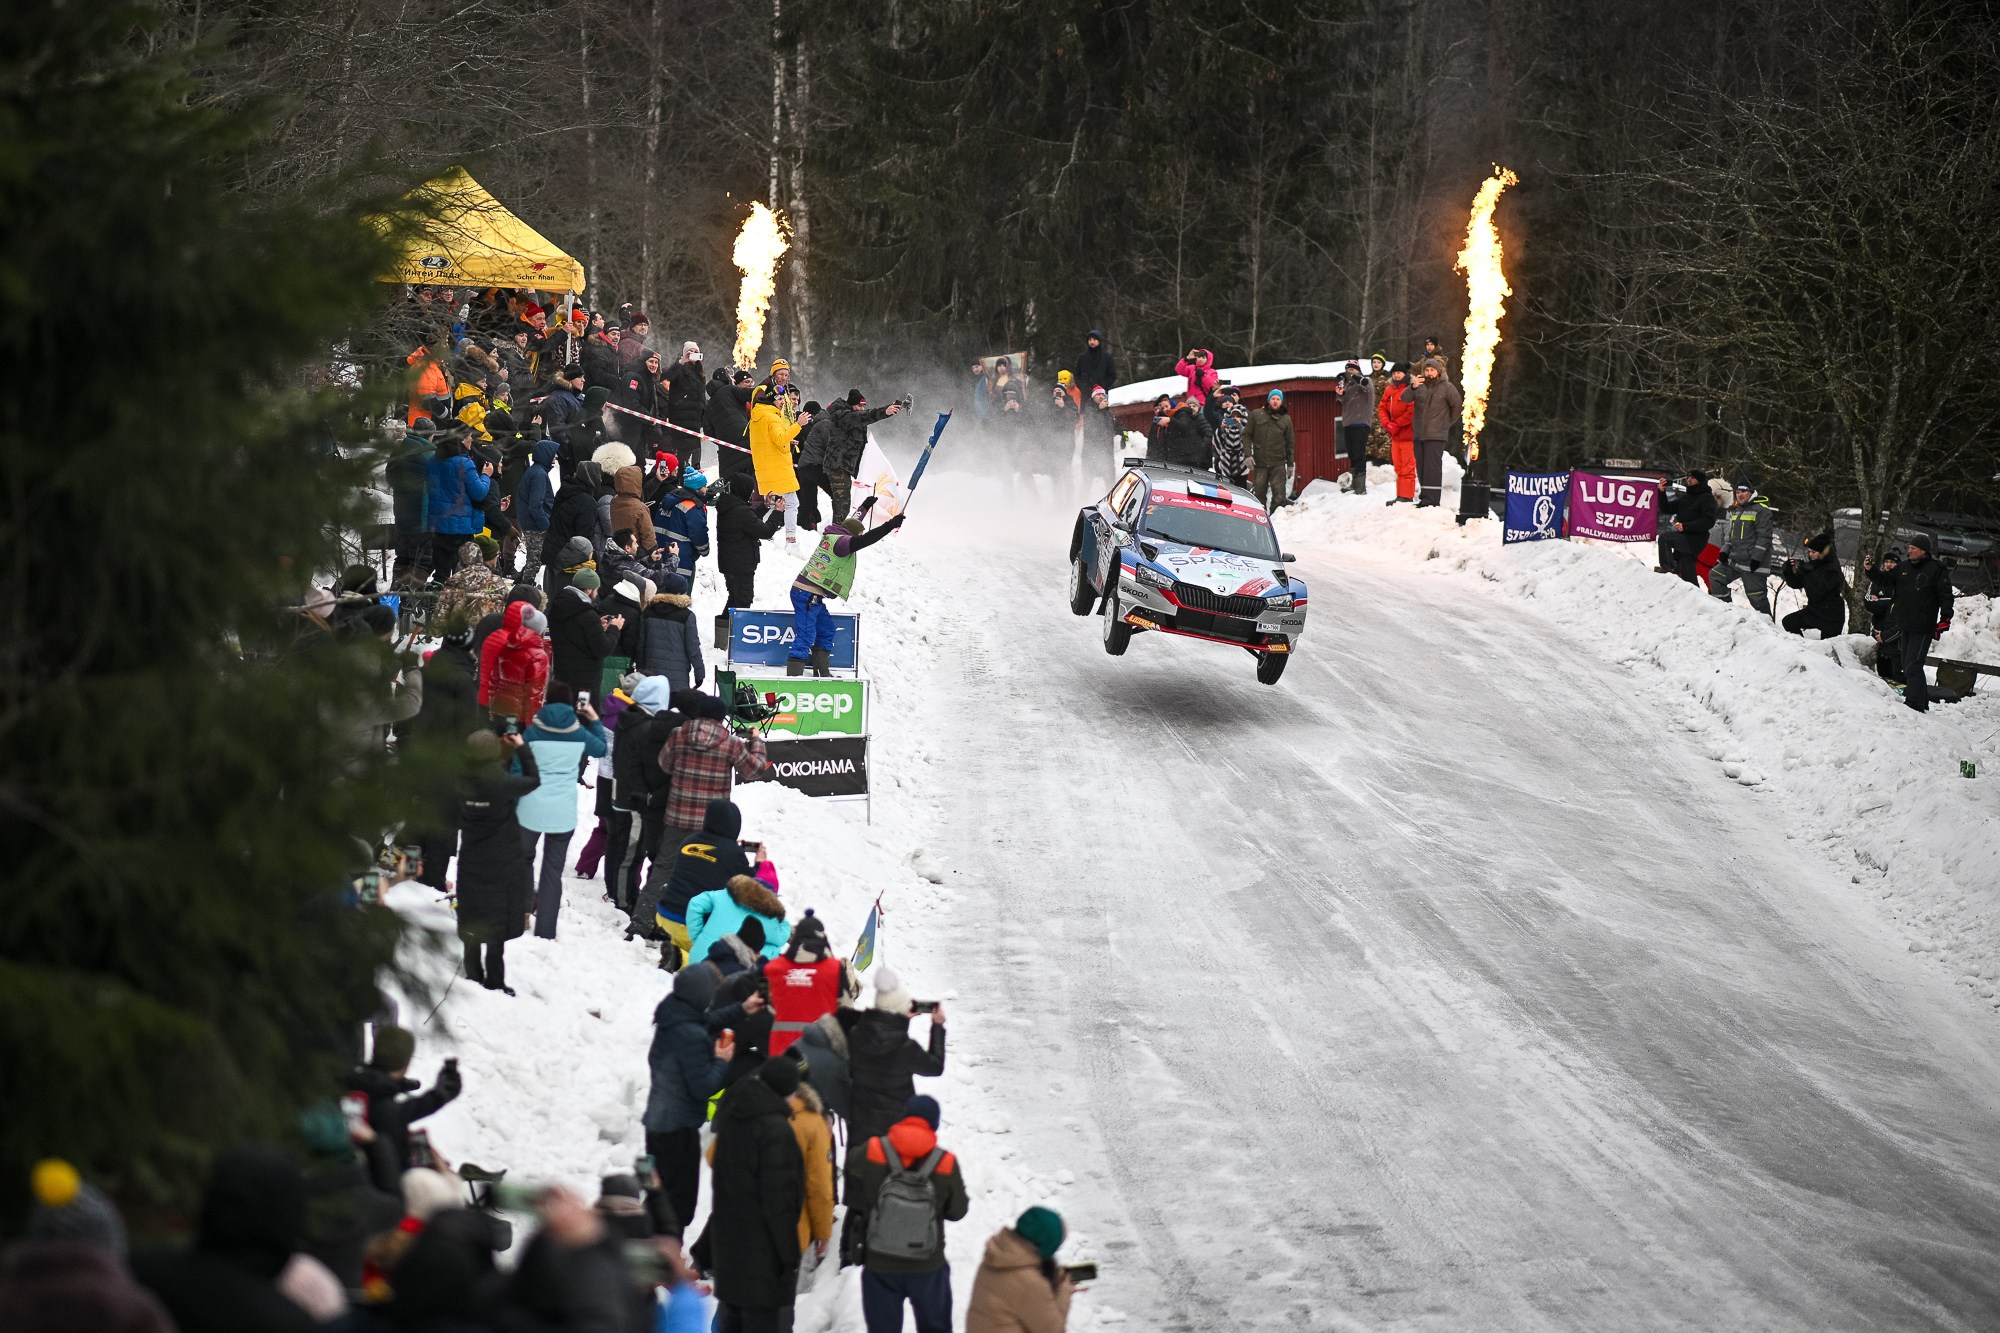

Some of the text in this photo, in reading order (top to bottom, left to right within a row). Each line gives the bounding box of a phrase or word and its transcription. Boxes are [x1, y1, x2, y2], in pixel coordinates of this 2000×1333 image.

[1580, 481, 1653, 509] LUGA
[1145, 504, 1155, 515] 2
[1595, 512, 1635, 529] SZFO
[1168, 556, 1260, 570] SPACE
[741, 625, 800, 645] SPA
[773, 758, 856, 778] YOKOHAMA
